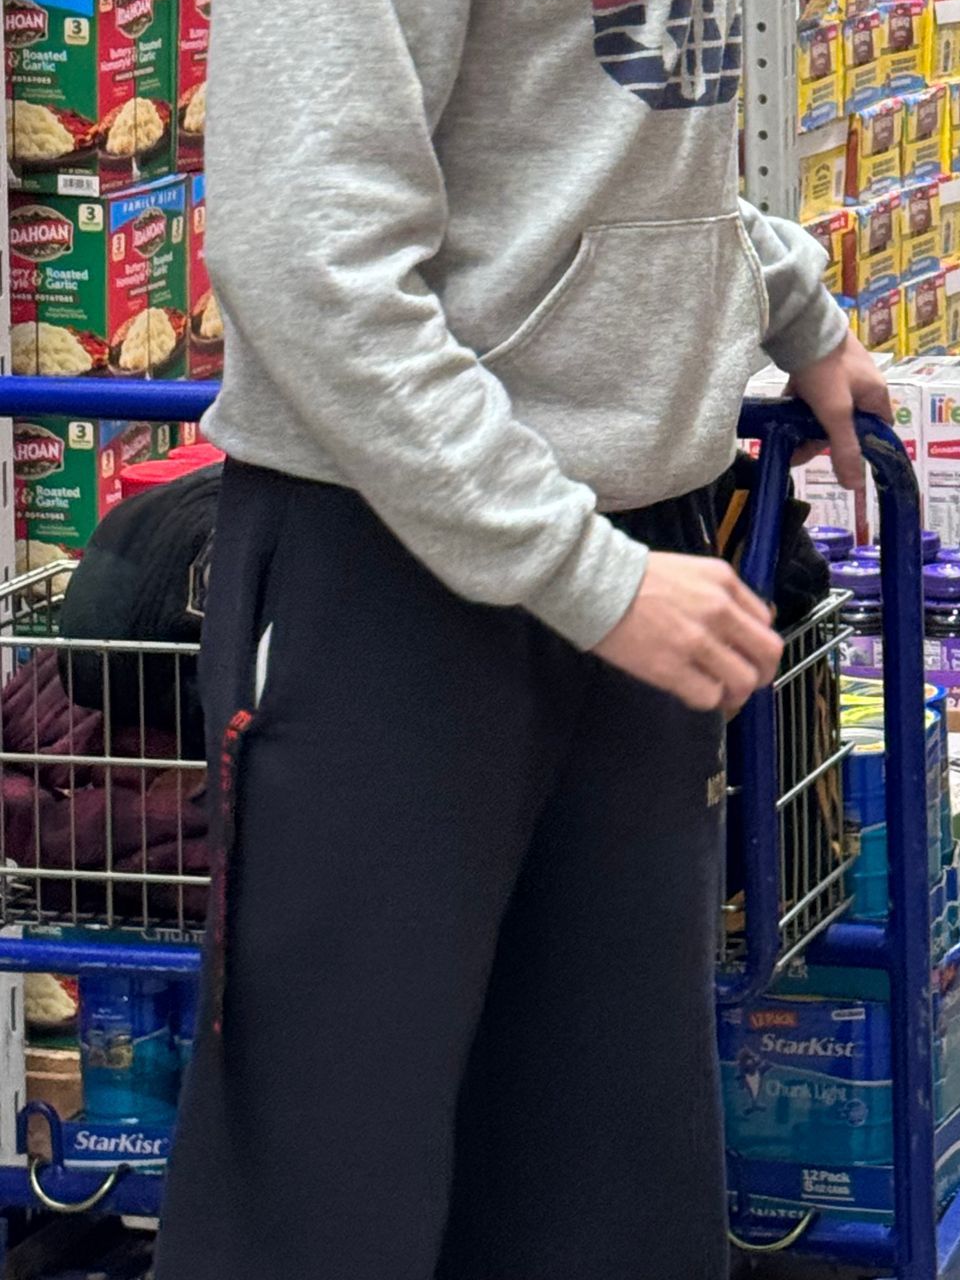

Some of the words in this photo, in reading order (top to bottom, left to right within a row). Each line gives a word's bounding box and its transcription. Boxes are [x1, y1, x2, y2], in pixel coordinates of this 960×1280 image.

[72, 21, 82, 36] 3
[22, 48, 67, 62] Roasted
[22, 60, 56, 72] Garlic
[86, 205, 97, 221] 3
[122, 197, 156, 214] FAMILY
[46, 267, 88, 281] Roasted
[45, 278, 78, 291] Garlic
[76, 423, 87, 439] 3
[36, 485, 80, 498] Roasted
[35, 496, 69, 508] Garlic
[761, 1033, 855, 1058] StarKist
[766, 1079, 811, 1099] Chunk
[813, 1083, 847, 1105] Light
[74, 1130, 162, 1155] StarKist
